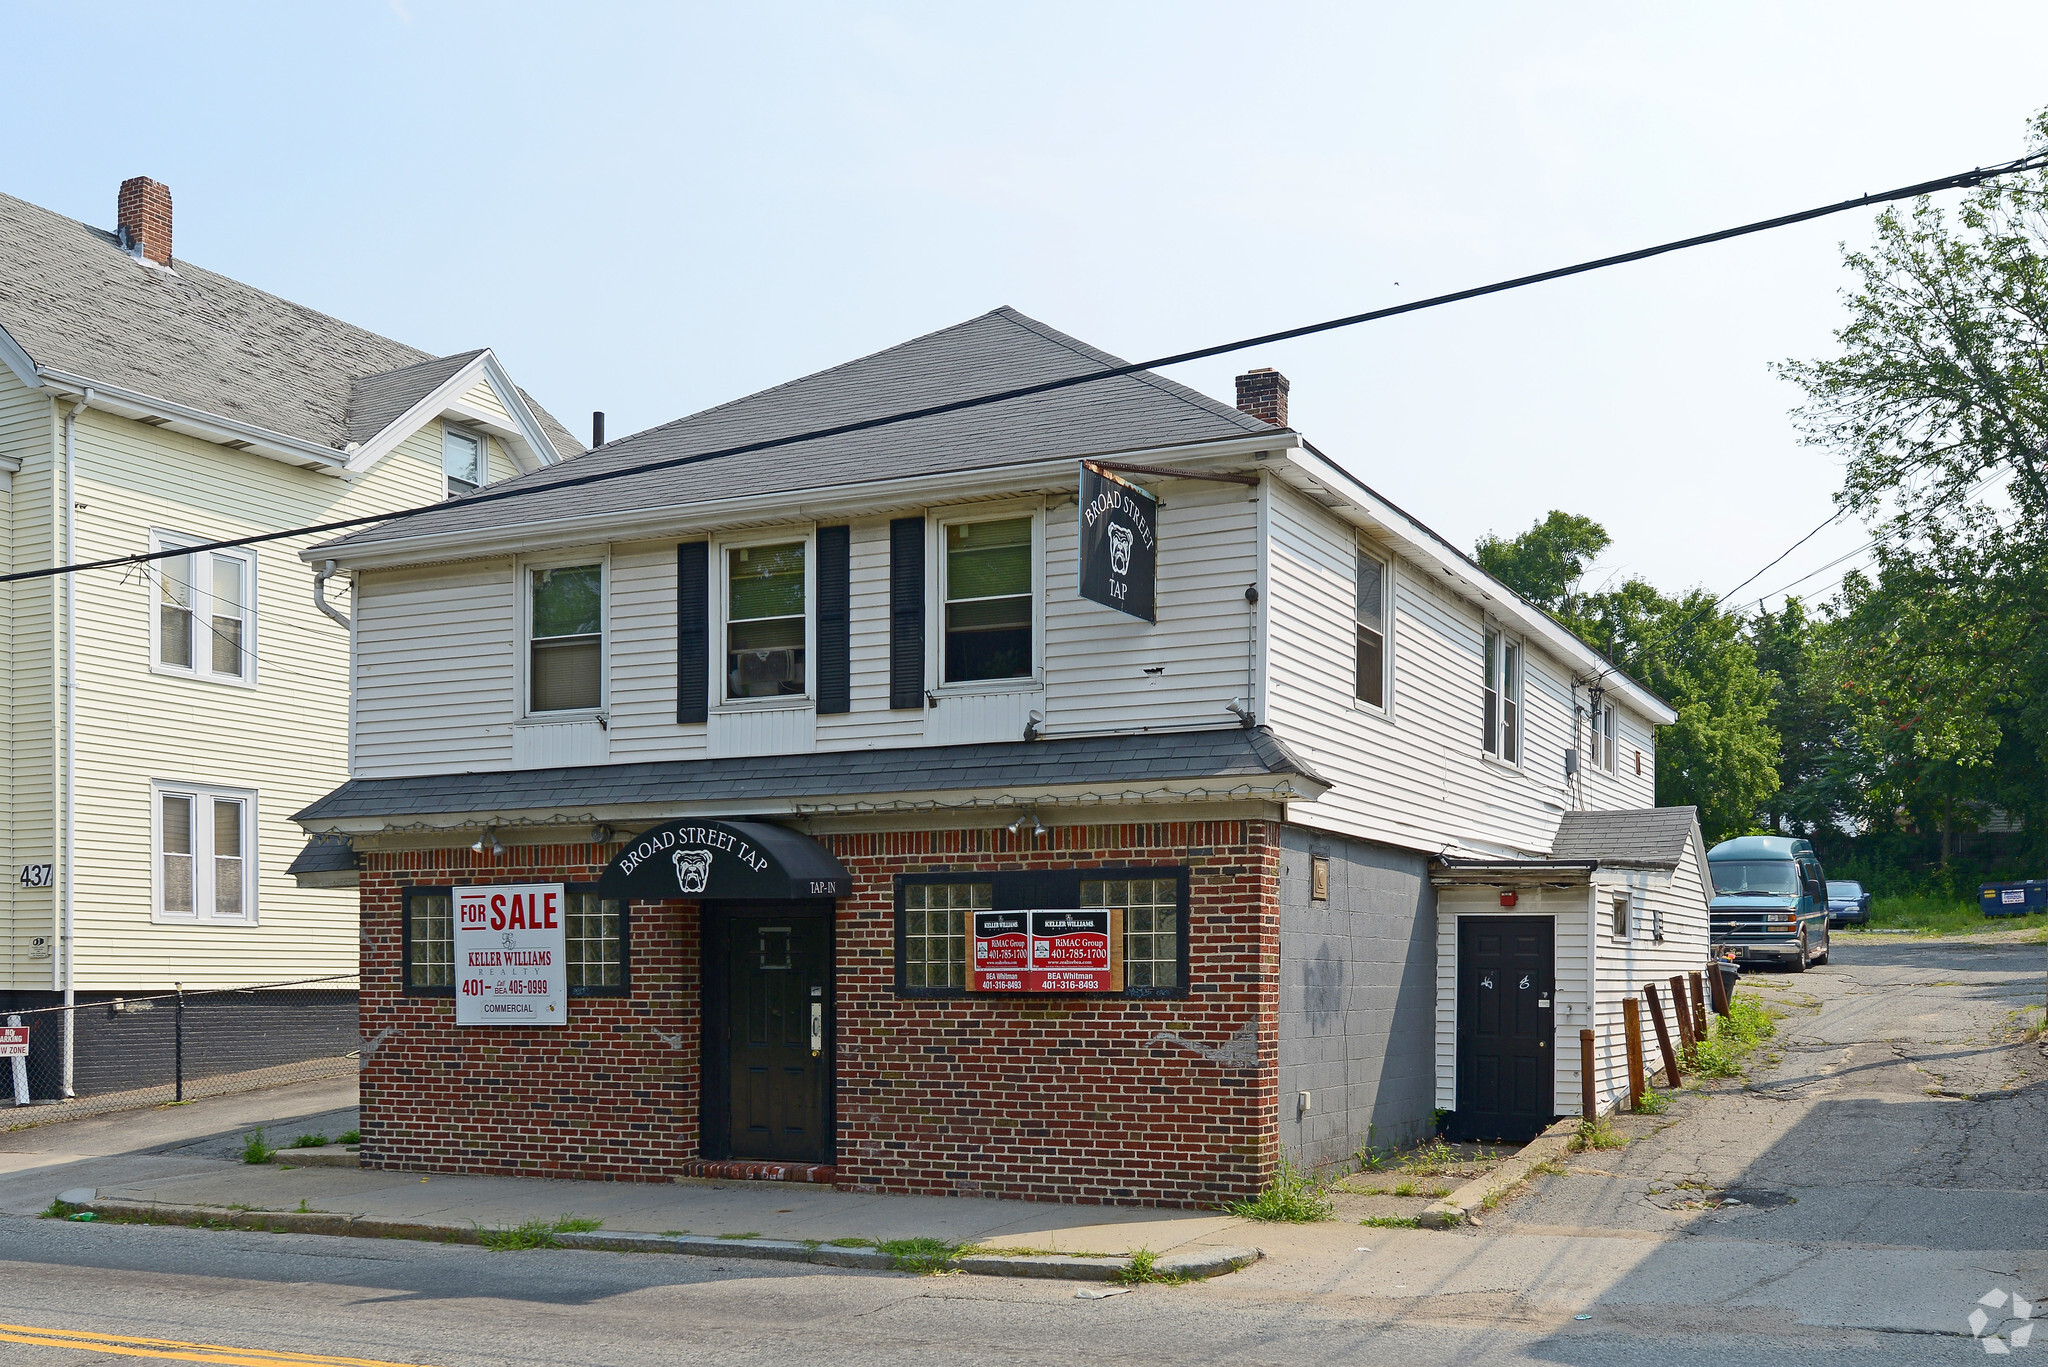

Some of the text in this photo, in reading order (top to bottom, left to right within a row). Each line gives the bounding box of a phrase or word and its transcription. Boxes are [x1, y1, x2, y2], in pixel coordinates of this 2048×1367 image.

[1084, 491, 1154, 550] BROAD STREET
[1109, 578, 1128, 600] TAP
[619, 827, 768, 876] BROAD STREET TAP
[20, 864, 52, 887] 437
[810, 881, 836, 894] TAP-IN
[461, 892, 559, 931] FOR SALE
[1044, 920, 1067, 928] KELLER
[1010, 939, 1025, 949] Group
[1055, 938, 1104, 949] RiMAC Group
[989, 949, 1028, 959] 401-785-1700
[1051, 948, 1107, 959] 401-785-1700
[468, 951, 551, 967] KELLER WILLIAMS
[478, 967, 540, 976] REALTY
[986, 972, 1018, 980] BEA Whitman
[1047, 972, 1093, 980] BEA Whitman
[462, 978, 492, 996] 401-
[508, 979, 548, 994] 405-0999
[982, 980, 1022, 989] 401-316-8493
[1041, 980, 1099, 989] 401-316-8493
[484, 1004, 533, 1013] COMMERCIAL
[0, 1035, 23, 1043] ARKING
[10, 1046, 26, 1054] ZONE
